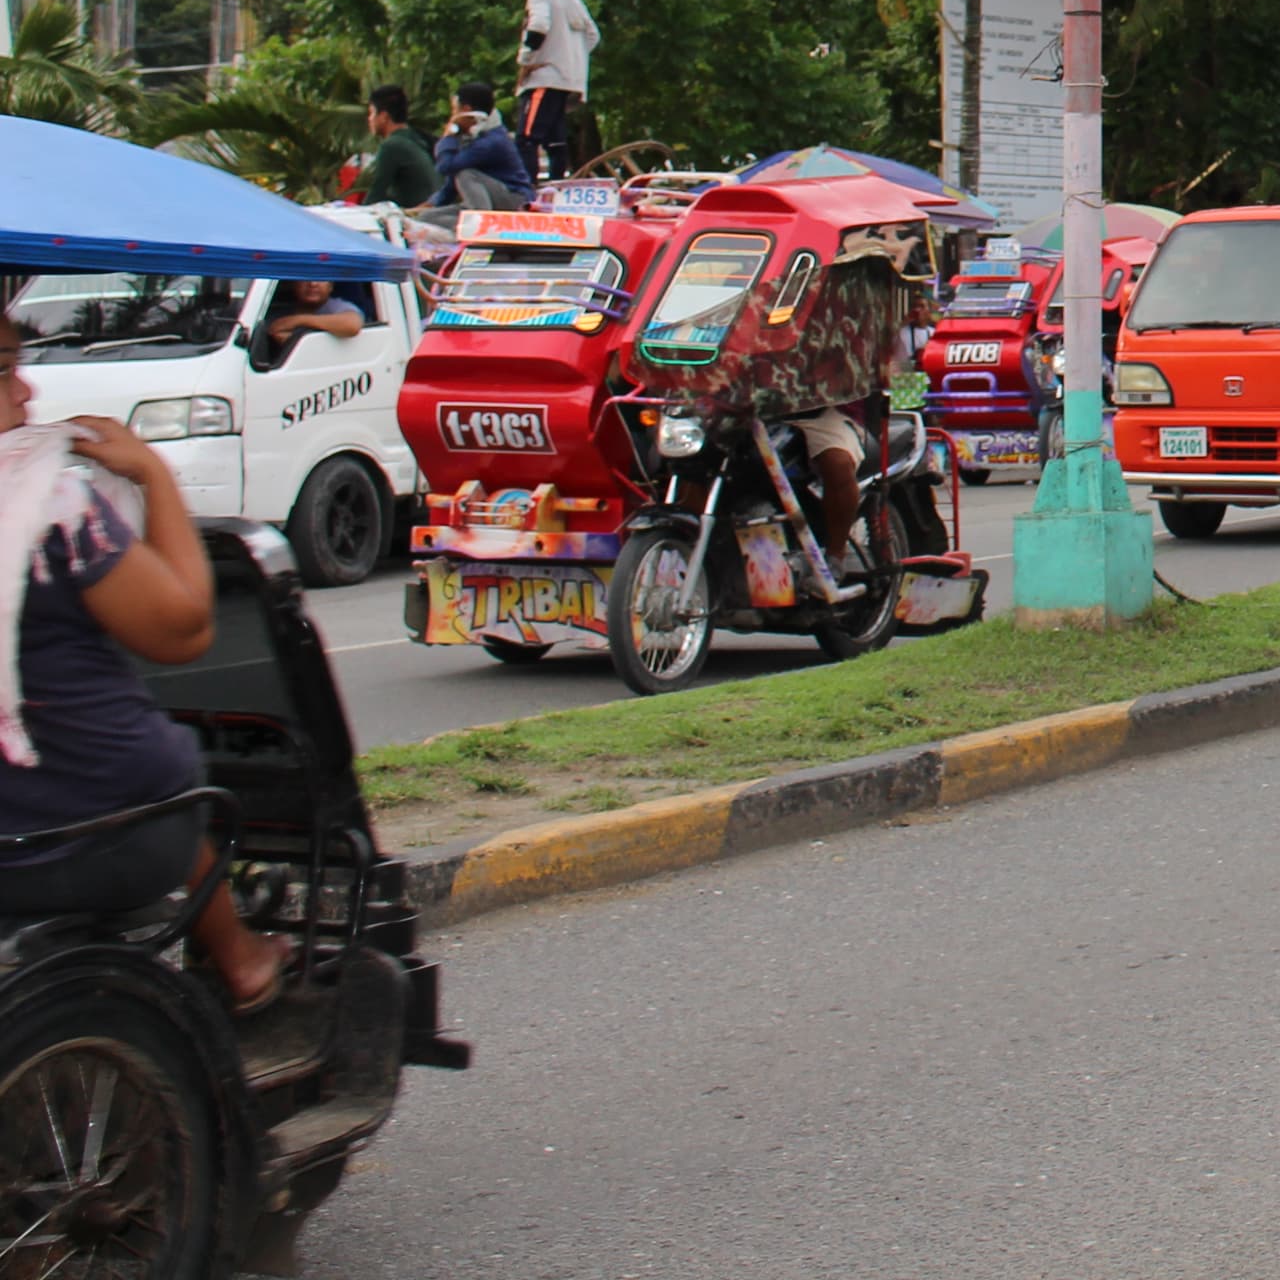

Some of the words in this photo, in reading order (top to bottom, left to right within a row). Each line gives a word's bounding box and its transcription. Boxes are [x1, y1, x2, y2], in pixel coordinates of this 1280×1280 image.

[564, 187, 609, 207] 1363
[281, 370, 372, 430] SPEEDO
[1164, 439, 1203, 454] 124101
[462, 576, 609, 644] TRIBAL
